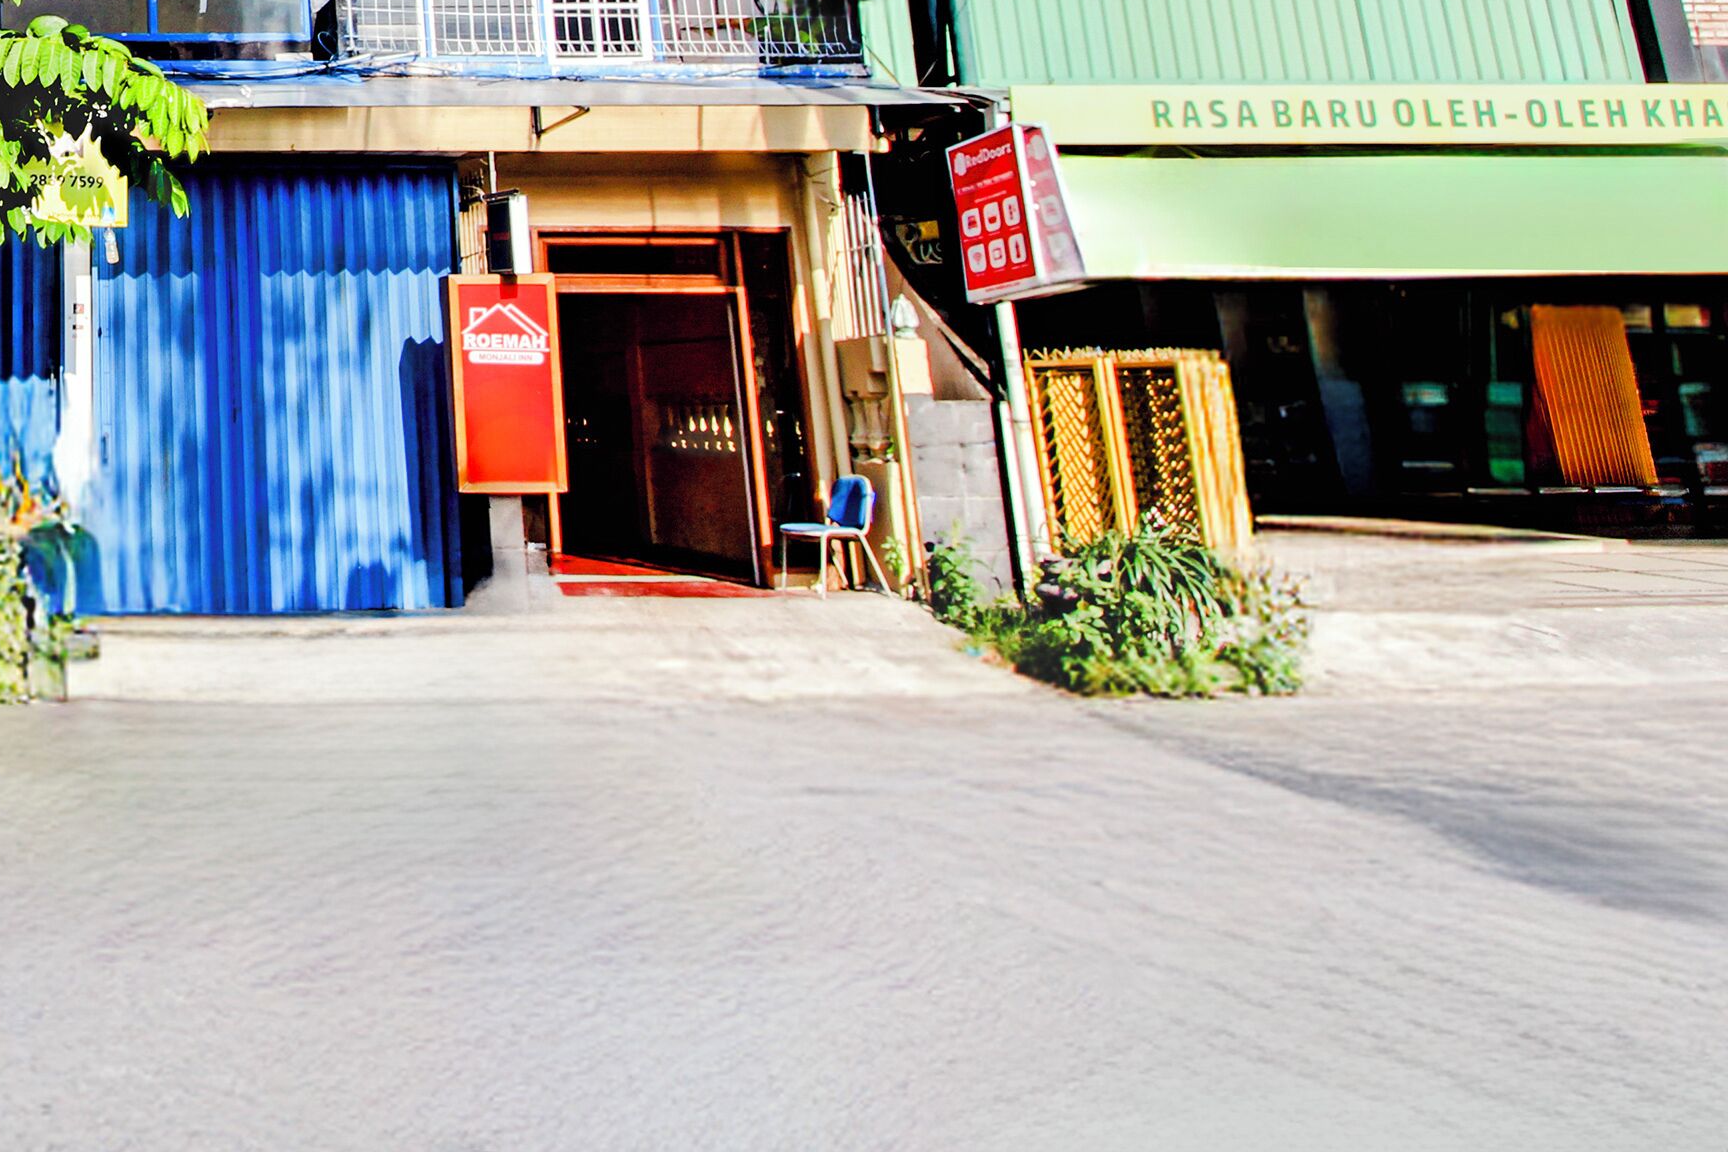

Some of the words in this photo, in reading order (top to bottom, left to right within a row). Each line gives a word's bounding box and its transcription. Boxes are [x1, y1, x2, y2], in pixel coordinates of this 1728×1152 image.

[1151, 99, 1258, 128] RASA
[1270, 99, 1377, 128] BARU
[1392, 98, 1628, 128] OLEH-OLEH
[1641, 98, 1728, 128] KHA
[69, 175, 104, 188] 7599
[463, 333, 547, 349] ROEMAH
